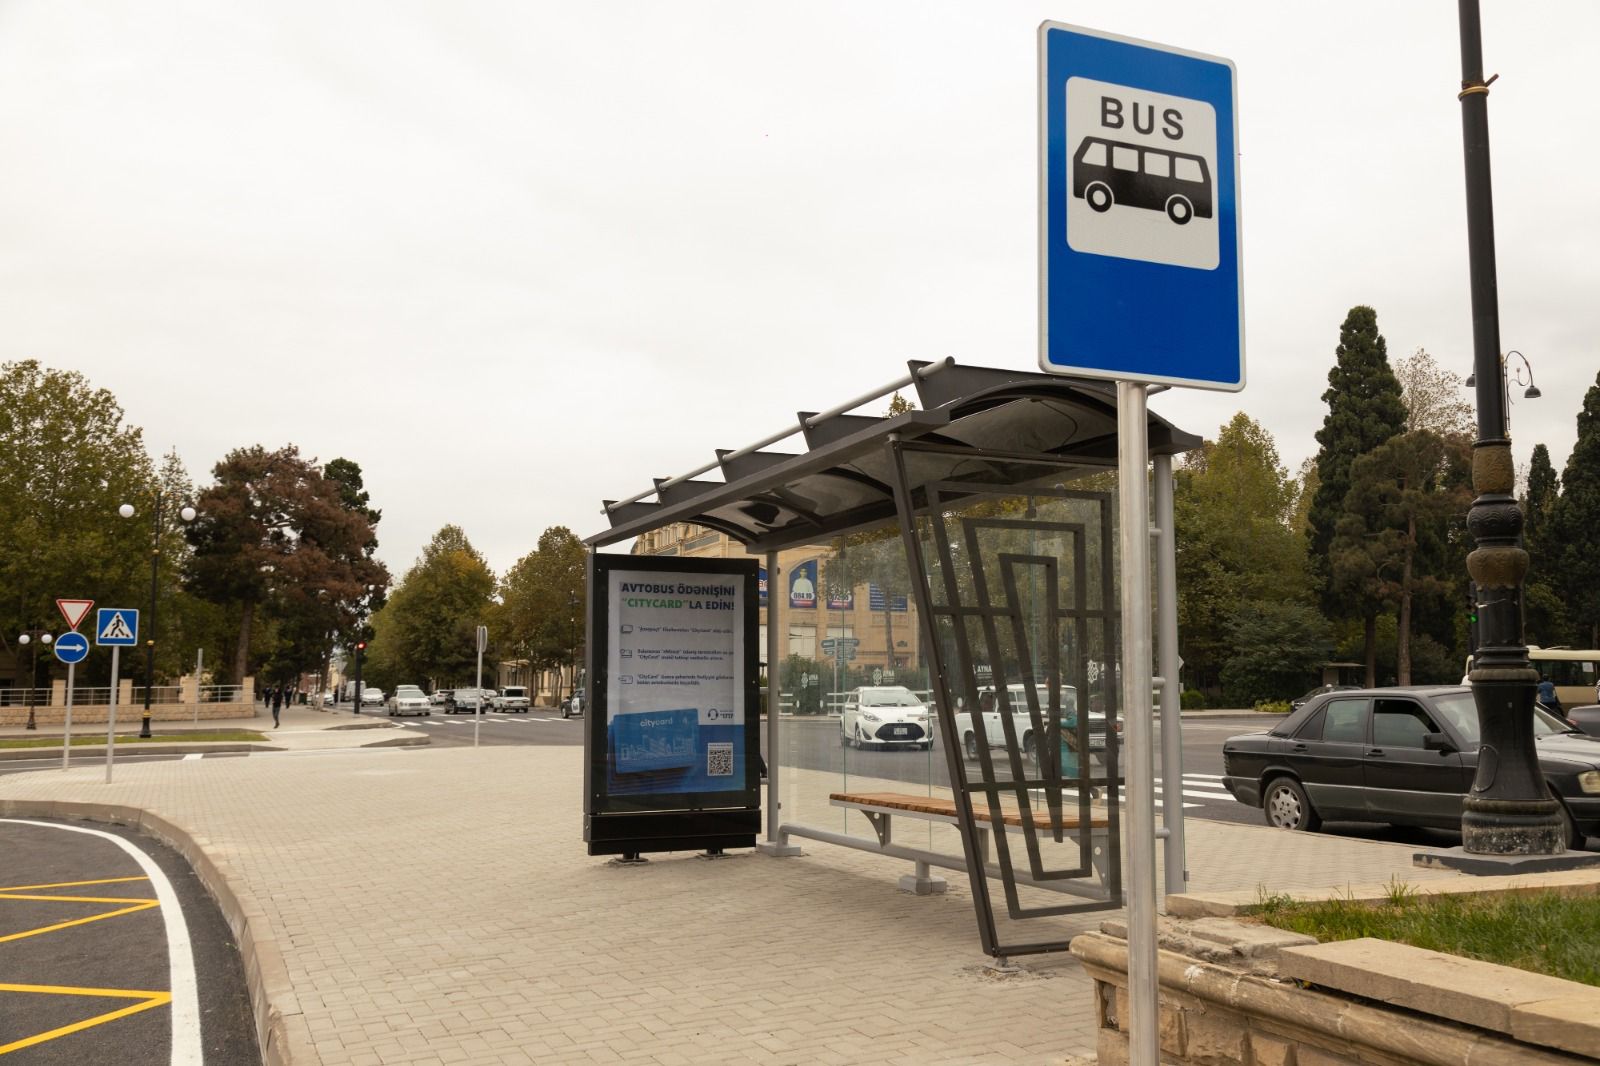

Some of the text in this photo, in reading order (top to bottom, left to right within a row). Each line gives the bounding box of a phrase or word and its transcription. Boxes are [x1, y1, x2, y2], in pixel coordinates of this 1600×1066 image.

[1101, 96, 1184, 140] BUS
[621, 583, 675, 595] AVTOBUS
[707, 599, 735, 611] EDİN!
[639, 717, 673, 728] citycard
